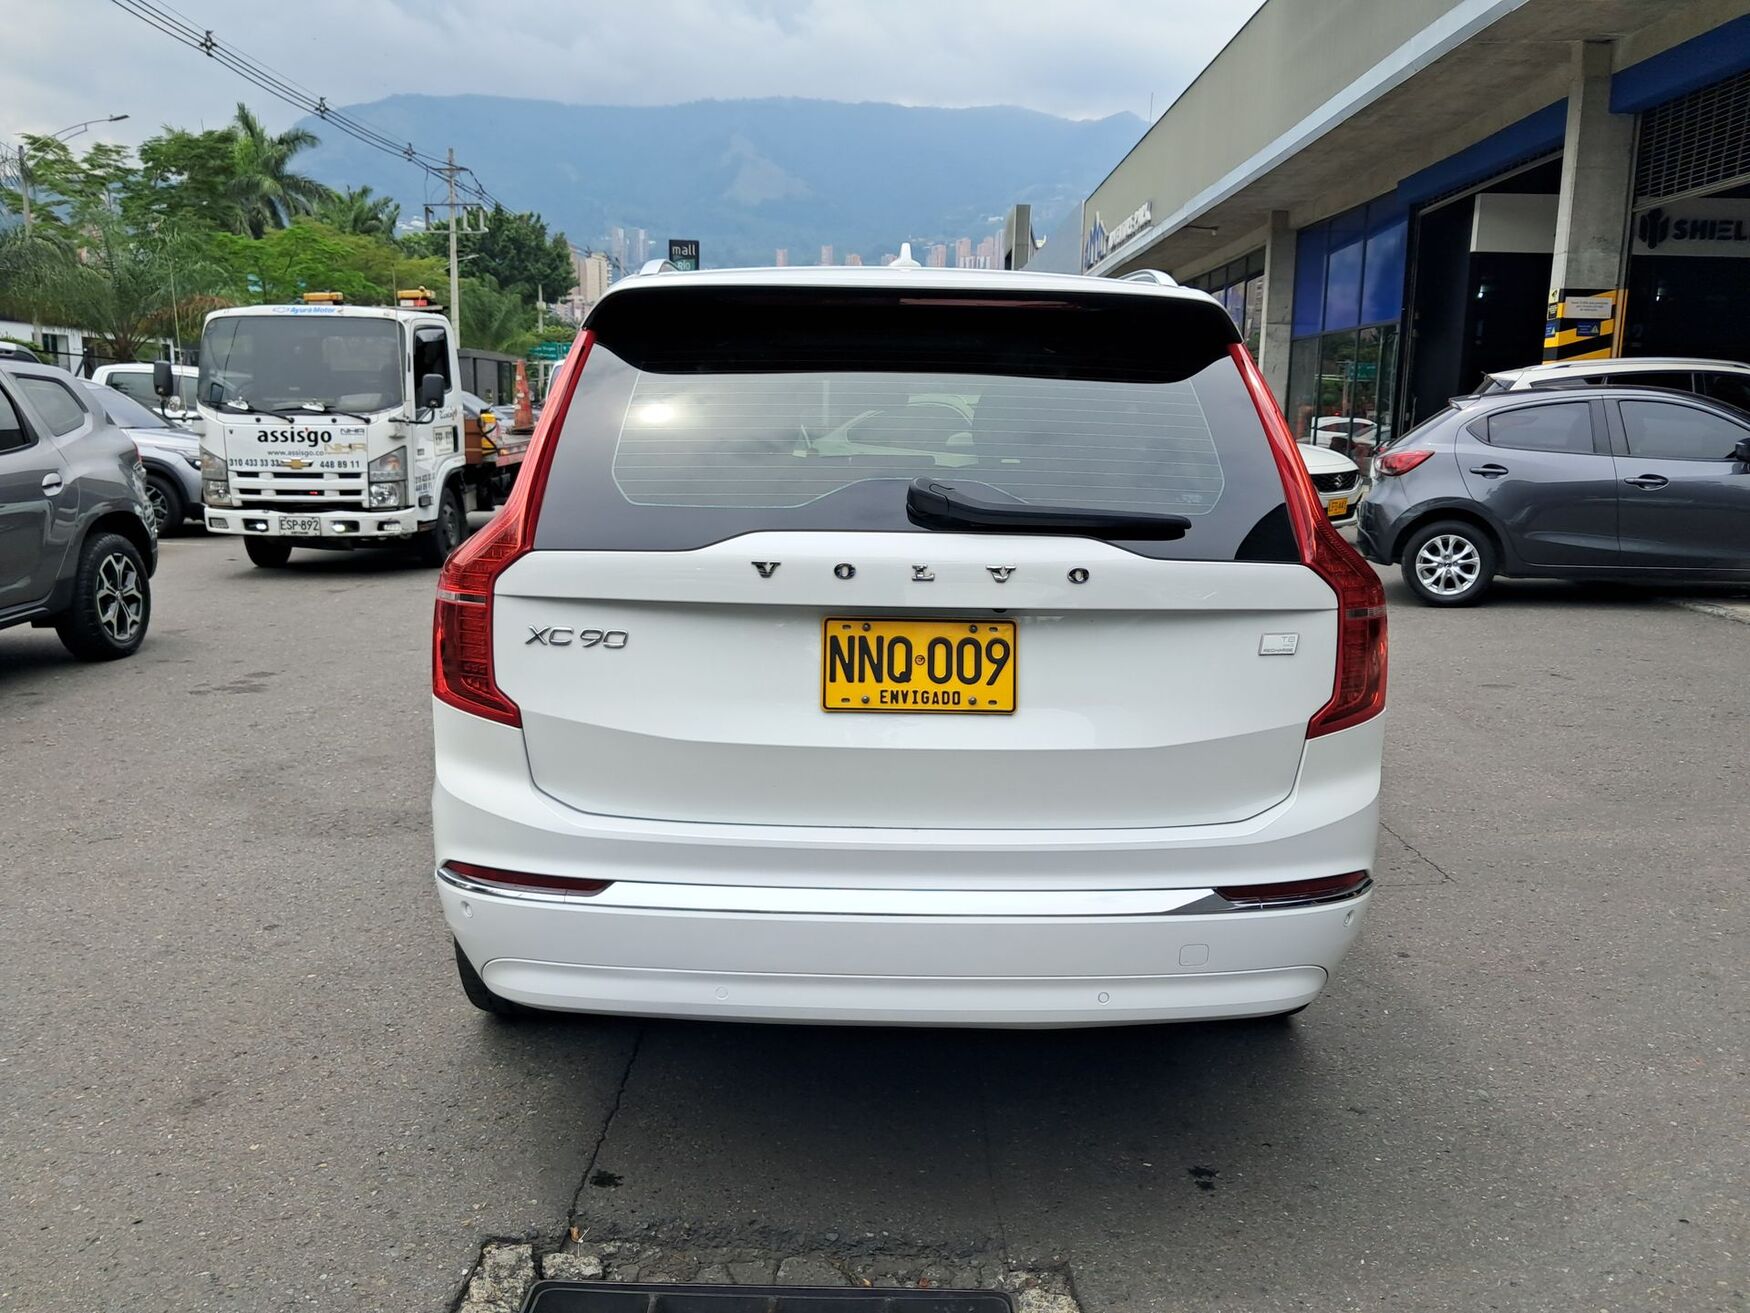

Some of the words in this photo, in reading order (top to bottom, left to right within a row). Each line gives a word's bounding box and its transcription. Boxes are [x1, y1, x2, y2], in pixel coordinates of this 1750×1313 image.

[1672, 219, 1750, 240] SHIEL
[672, 244, 696, 256] mall
[229, 459, 243, 467] 310
[245, 459, 258, 467] 433
[260, 459, 269, 467] 33
[280, 519, 320, 531] ESP-892
[751, 561, 1091, 584] VOLVO
[880, 690, 961, 706] ENVIGADO
